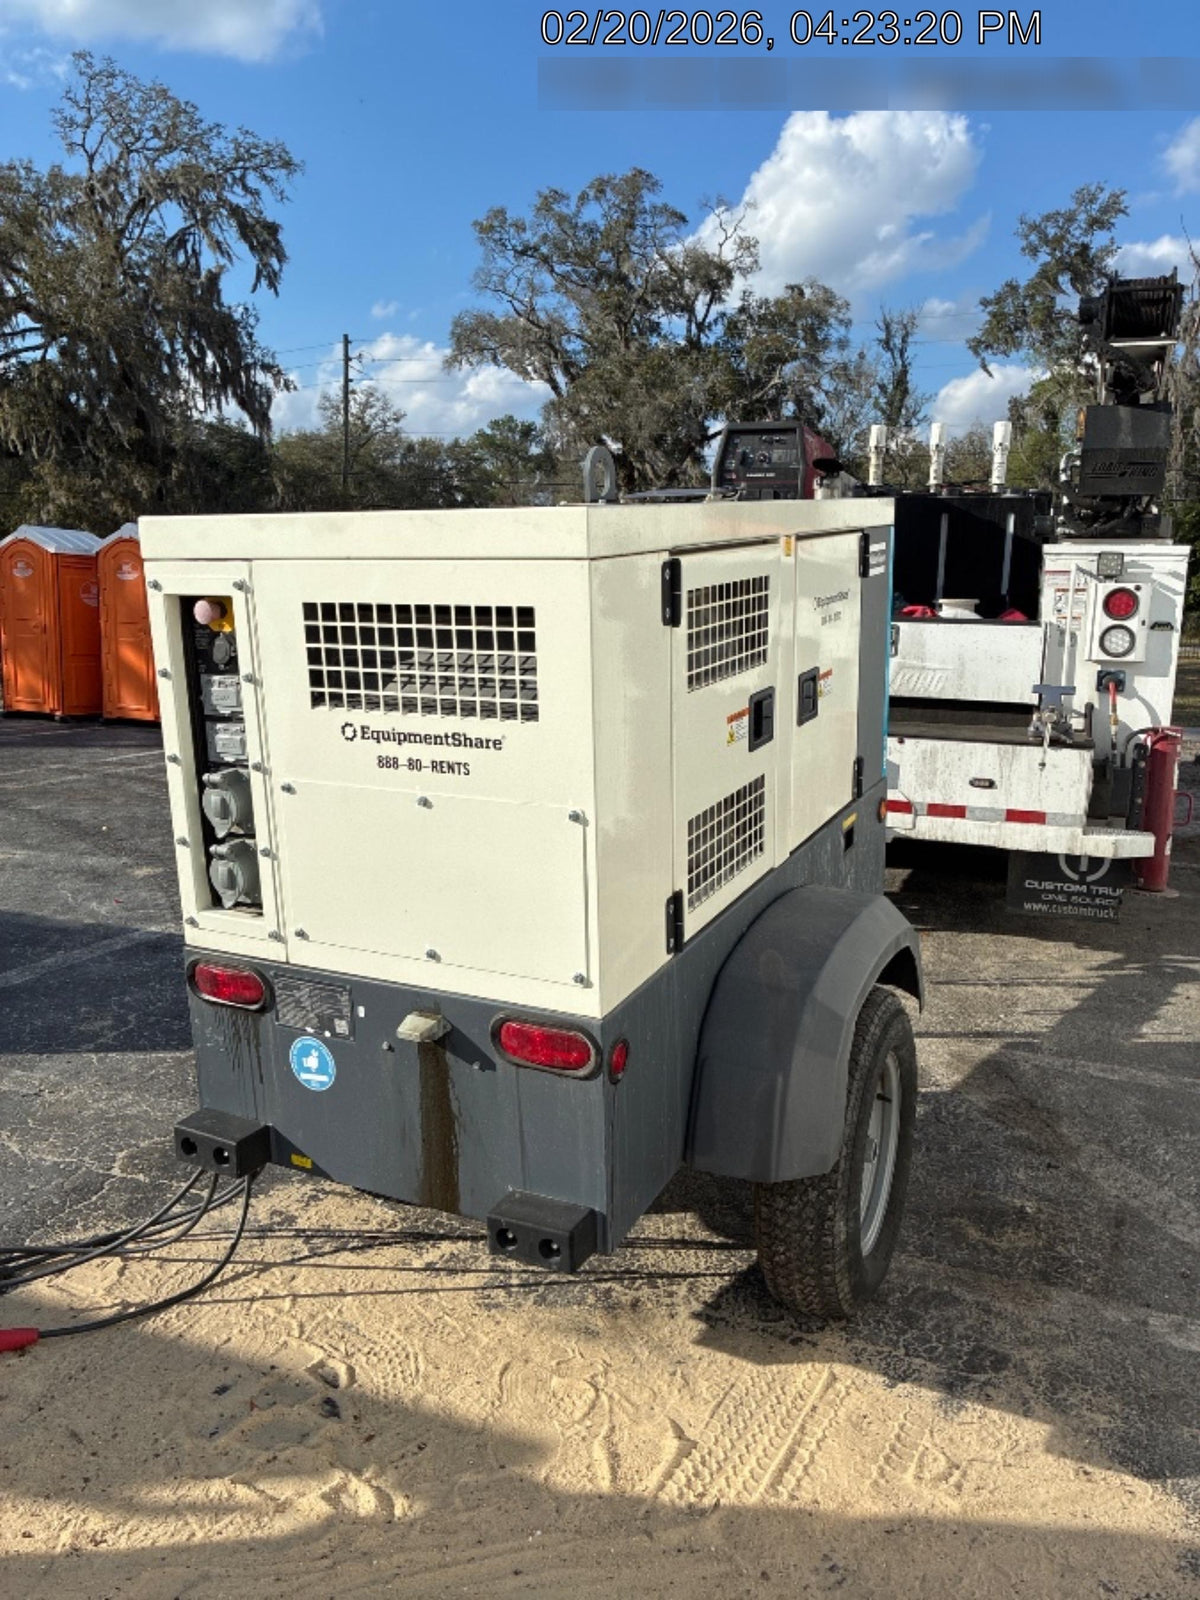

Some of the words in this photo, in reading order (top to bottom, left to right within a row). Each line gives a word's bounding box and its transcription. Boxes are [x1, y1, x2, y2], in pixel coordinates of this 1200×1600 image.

[360, 724, 503, 751] EquipmentShare
[377, 754, 471, 777] 888-80-RENTS
[1025, 880, 1088, 893] CUSTOM
[1091, 886, 1125, 896] TRU
[1042, 893, 1068, 902] ONE
[1024, 902, 1120, 919] www.customtruck.
